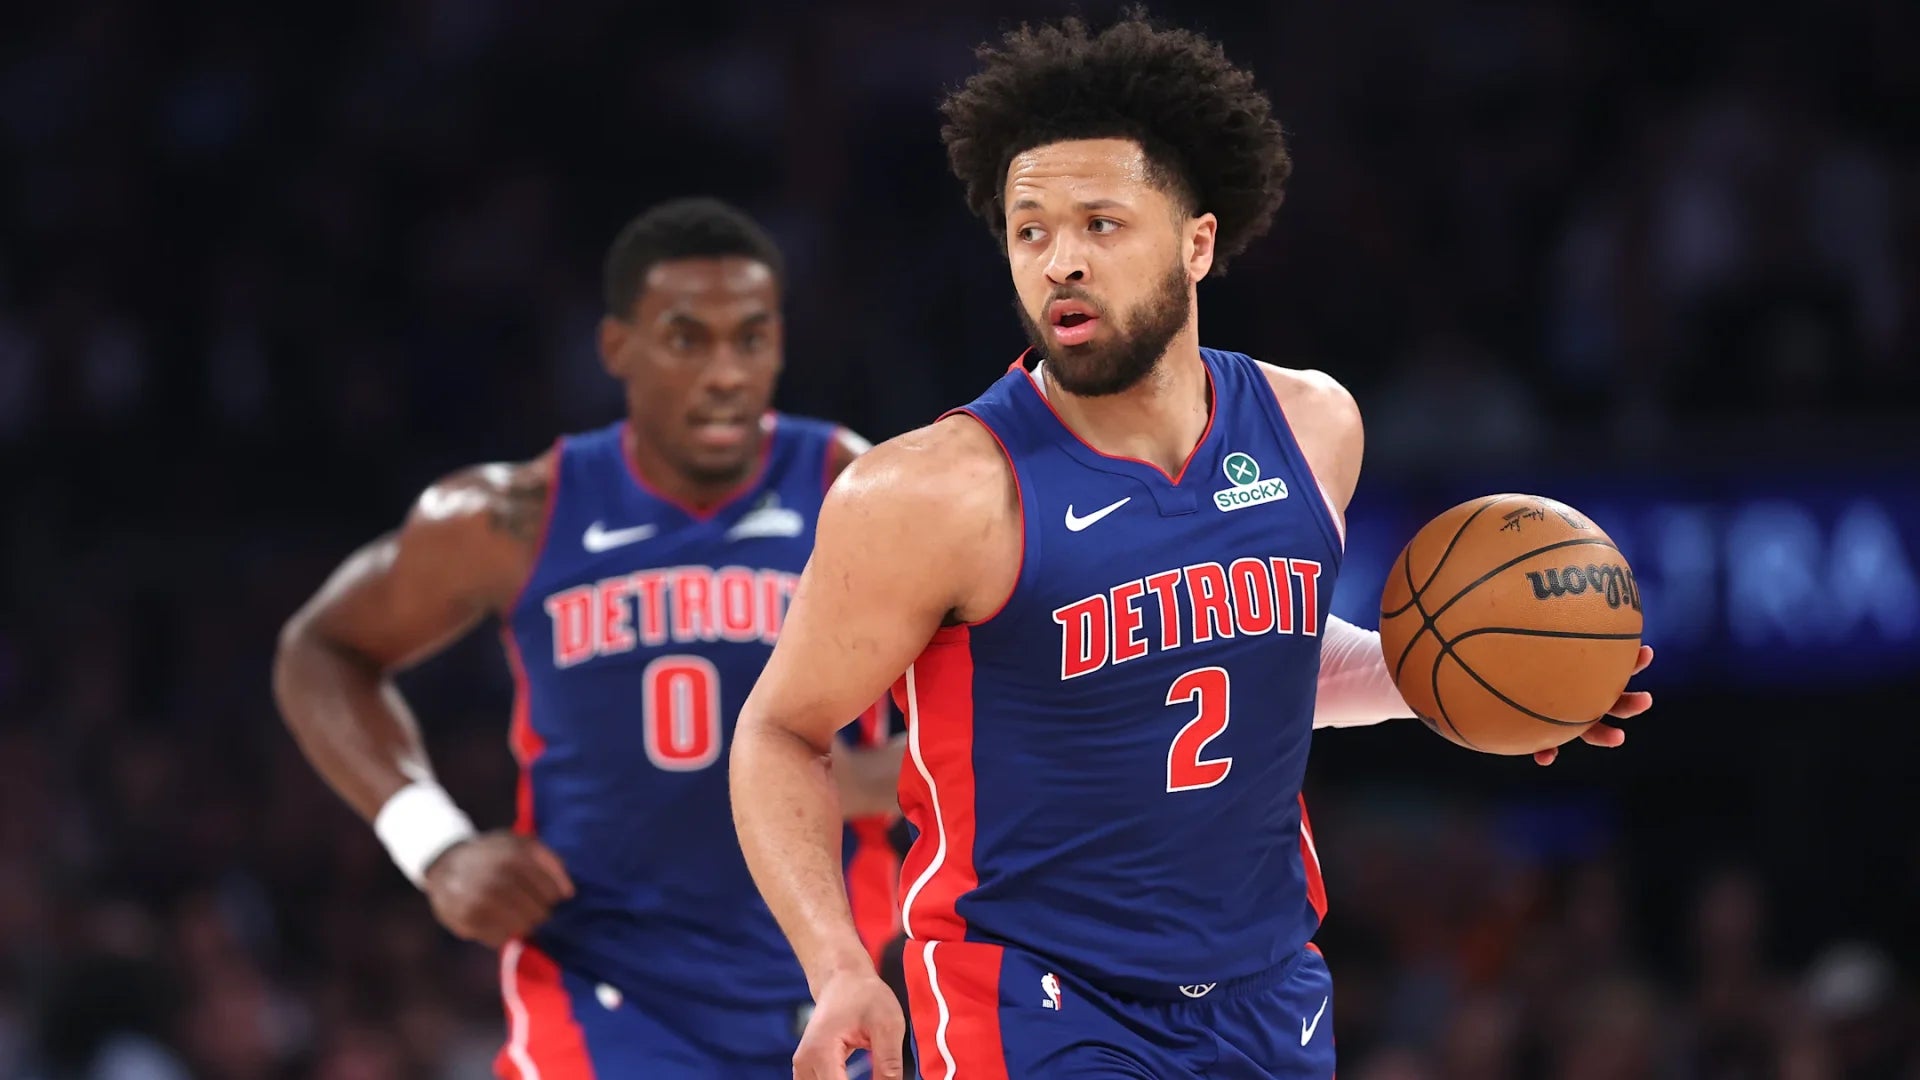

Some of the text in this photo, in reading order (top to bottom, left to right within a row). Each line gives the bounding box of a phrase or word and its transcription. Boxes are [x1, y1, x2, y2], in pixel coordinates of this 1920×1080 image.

[1216, 481, 1287, 508] StockX
[545, 564, 801, 669] DETROI
[1052, 556, 1322, 681] DETROIT
[641, 654, 722, 772] 0
[1165, 666, 1233, 793] 2
